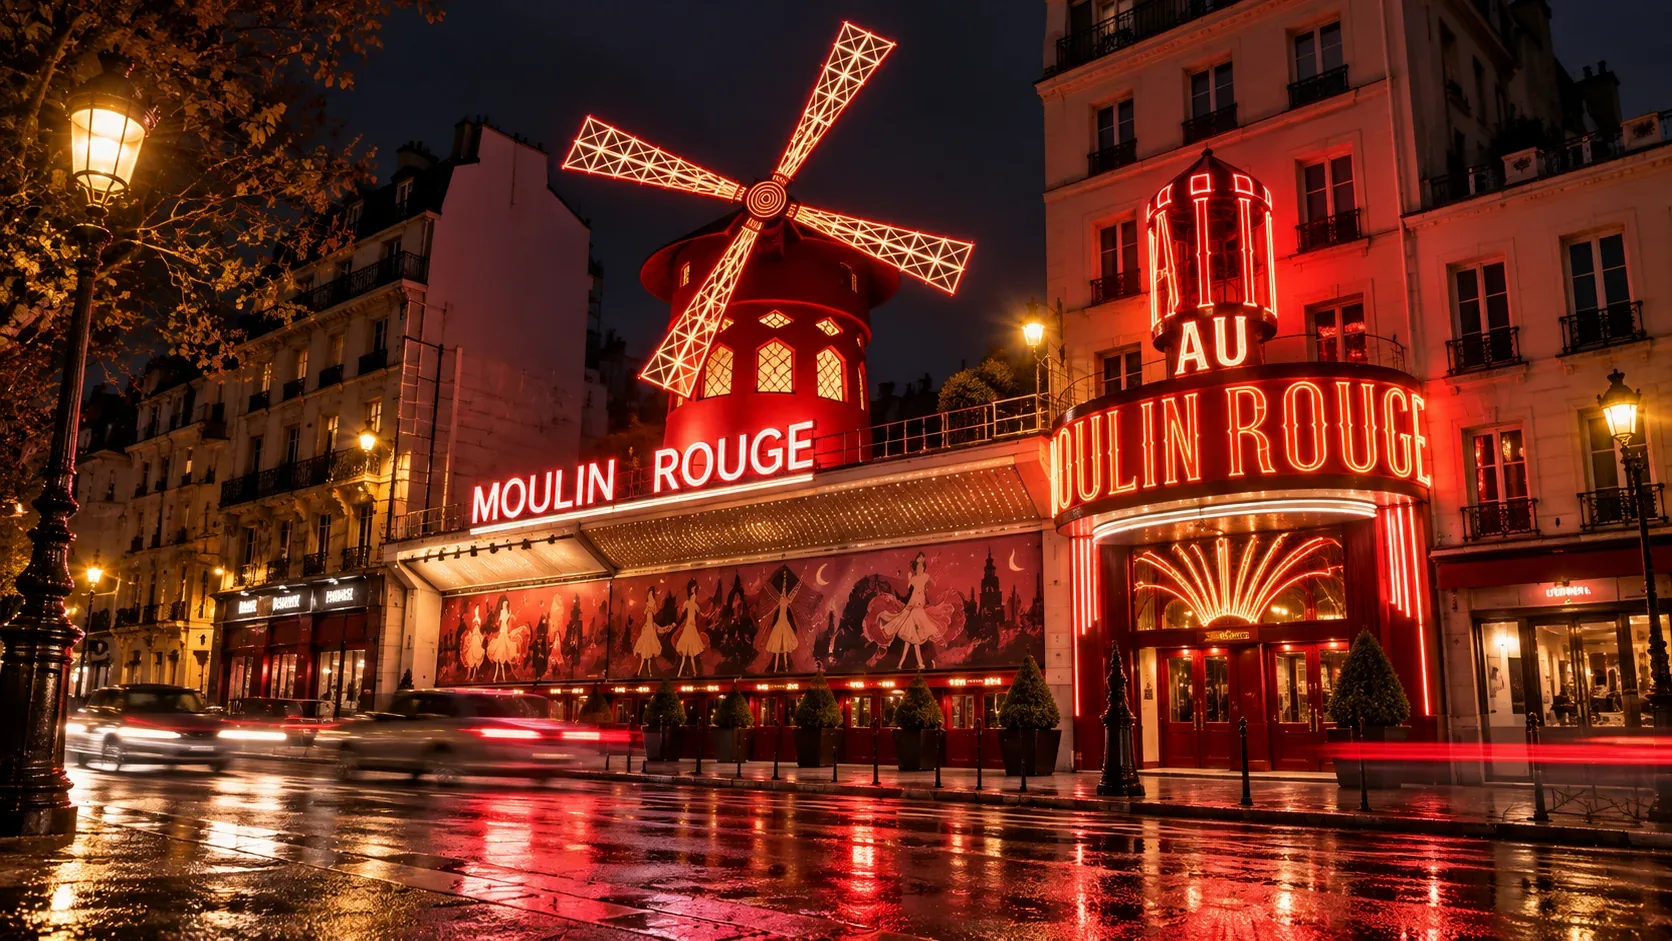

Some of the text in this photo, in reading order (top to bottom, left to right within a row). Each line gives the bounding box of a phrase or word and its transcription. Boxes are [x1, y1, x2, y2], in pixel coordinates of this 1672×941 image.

[1175, 315, 1247, 375] AU
[471, 420, 814, 524] MOULIN ROUGE
[1224, 380, 1431, 488] ROUGE
